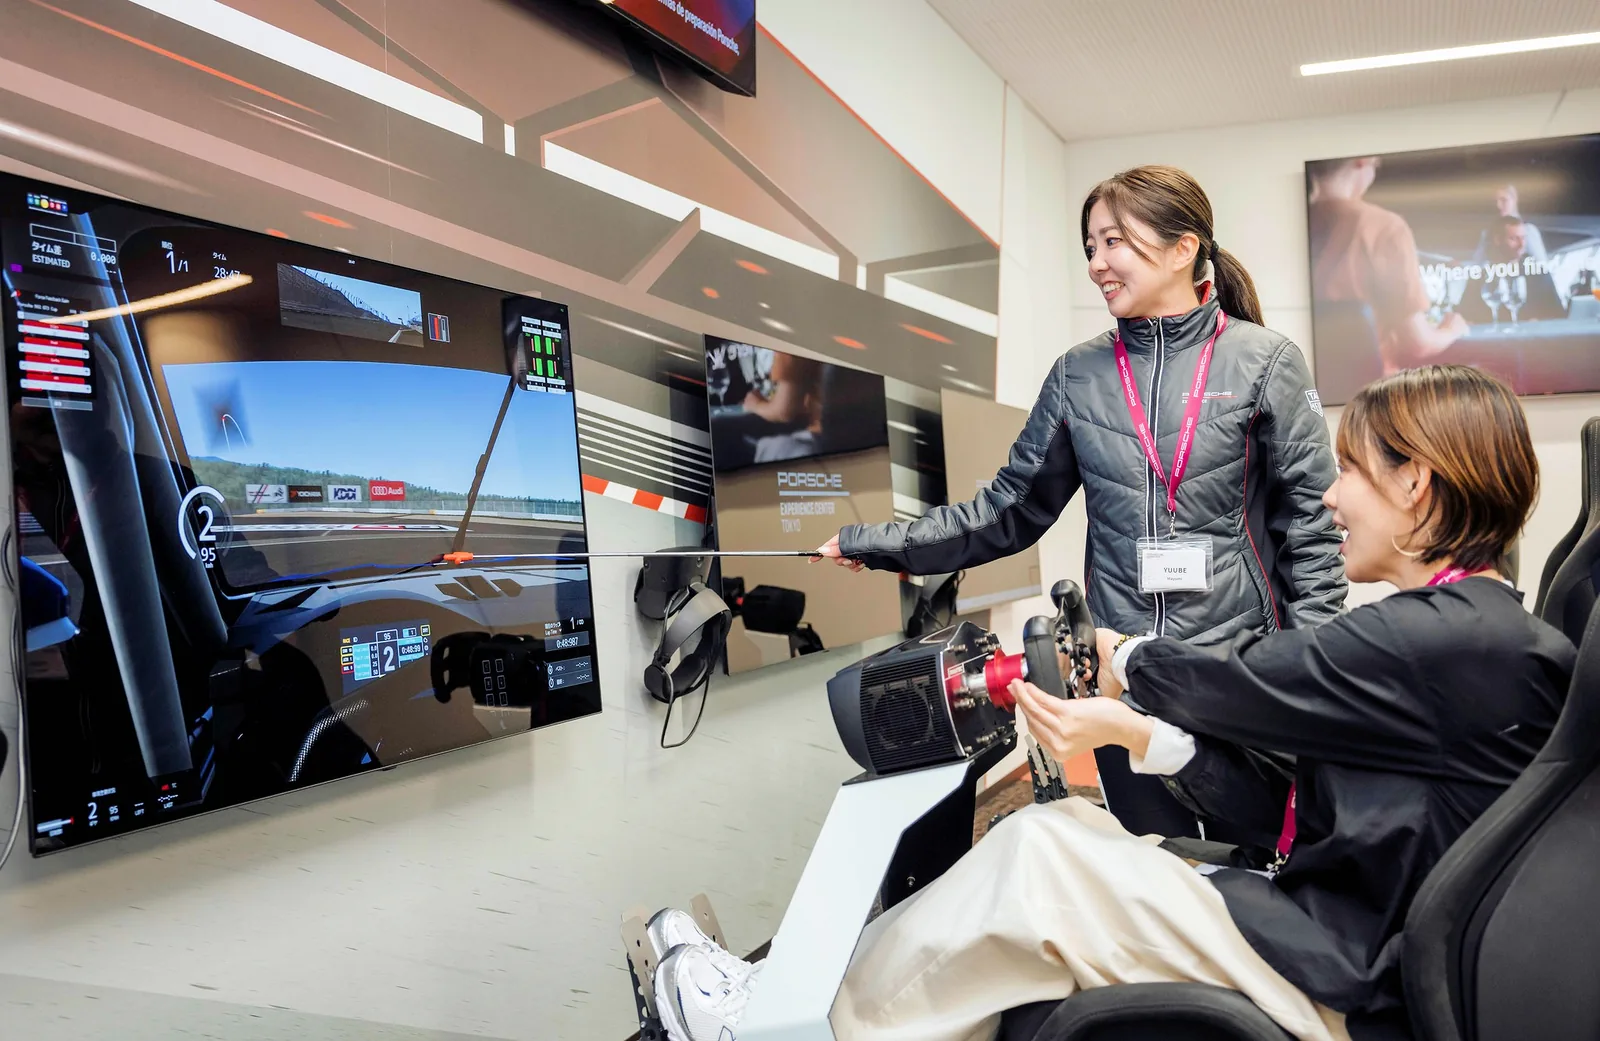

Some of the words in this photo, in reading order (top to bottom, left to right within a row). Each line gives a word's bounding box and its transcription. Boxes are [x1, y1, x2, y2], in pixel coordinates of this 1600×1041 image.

[676, 2, 685, 17] de
[685, 9, 717, 40] preparación
[32, 254, 71, 268] ESTIMATED
[91, 251, 117, 265] 0.000
[1419, 263, 1482, 281] Where
[1484, 261, 1520, 283] you
[1523, 256, 1560, 276] fin
[1119, 355, 1137, 407] PORSCHE
[1193, 342, 1211, 398] PORSCHE
[1138, 422, 1163, 479] PORSCHE
[1174, 416, 1194, 477] PORSCHE
[387, 486, 404, 495] Audi
[777, 471, 843, 488] PORSCHE
[197, 505, 217, 541] 2
[781, 518, 801, 533] TOKYO
[201, 547, 216, 561] 95
[383, 645, 396, 672] 2
[88, 801, 98, 820] 2
